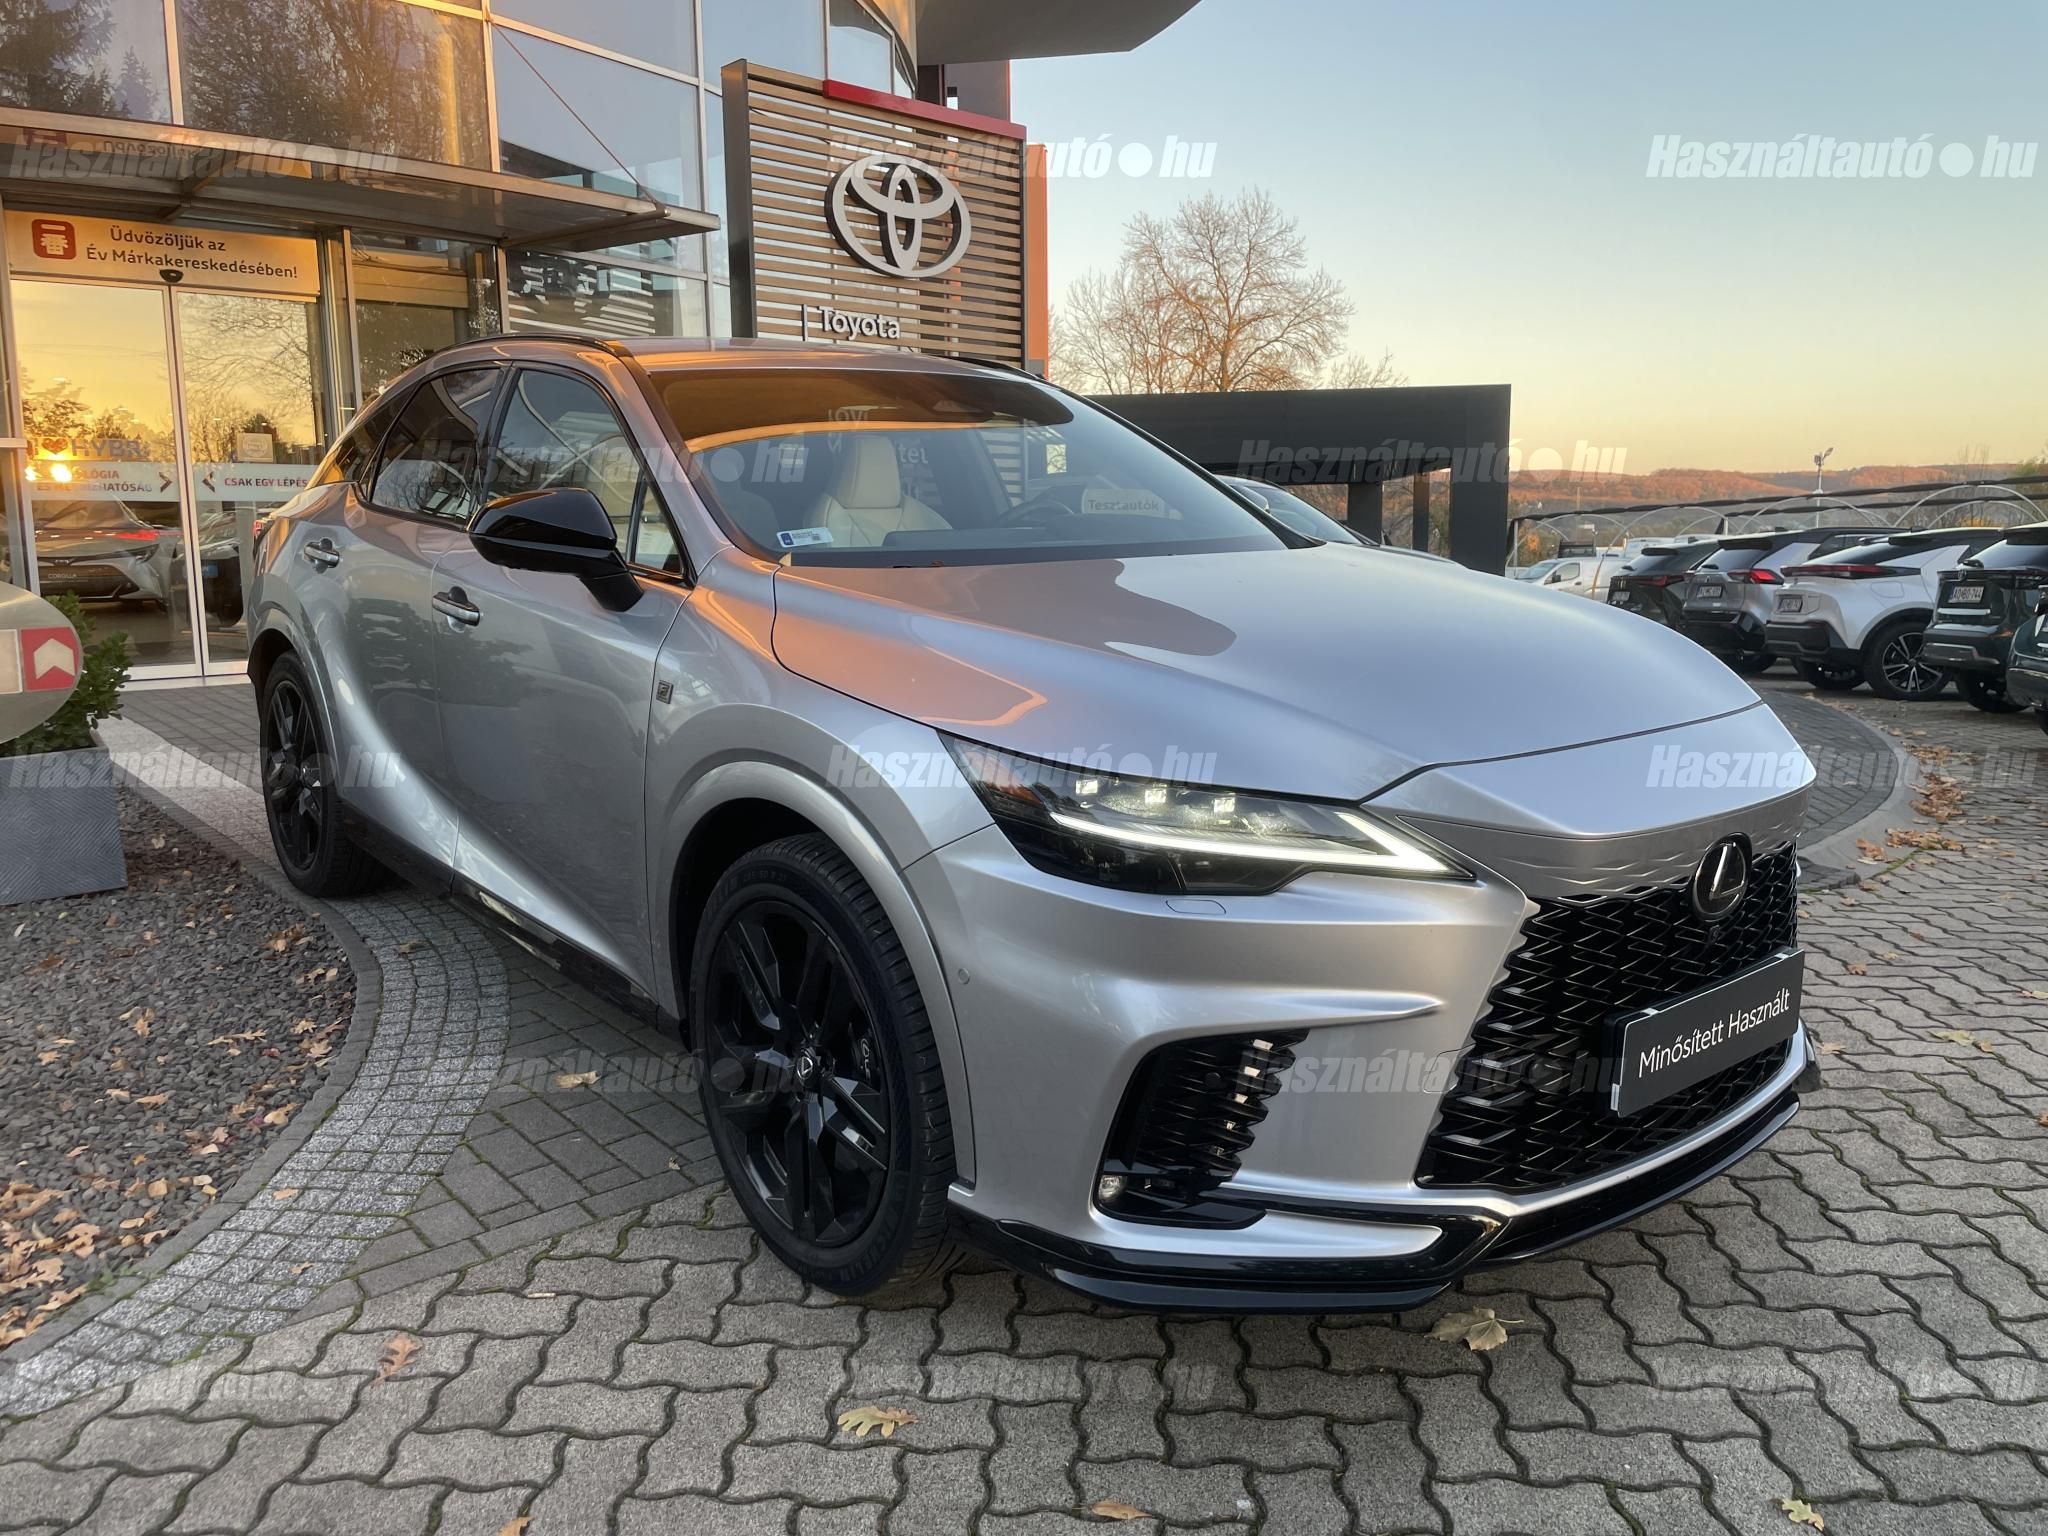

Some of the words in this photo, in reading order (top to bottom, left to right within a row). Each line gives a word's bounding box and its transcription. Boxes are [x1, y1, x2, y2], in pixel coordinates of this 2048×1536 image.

[110, 225, 204, 251] Üdvözöljük
[208, 241, 226, 251] az
[87, 243, 107, 261] Év
[113, 249, 298, 279] Márkakereskedésében!
[818, 305, 900, 340] Toyota
[224, 477, 253, 487] CSAK
[255, 478, 275, 487] EGY
[1088, 499, 1159, 512] Tesztautók
[1638, 1022, 1724, 1078] Minősített
[1728, 987, 1791, 1039] Használt
